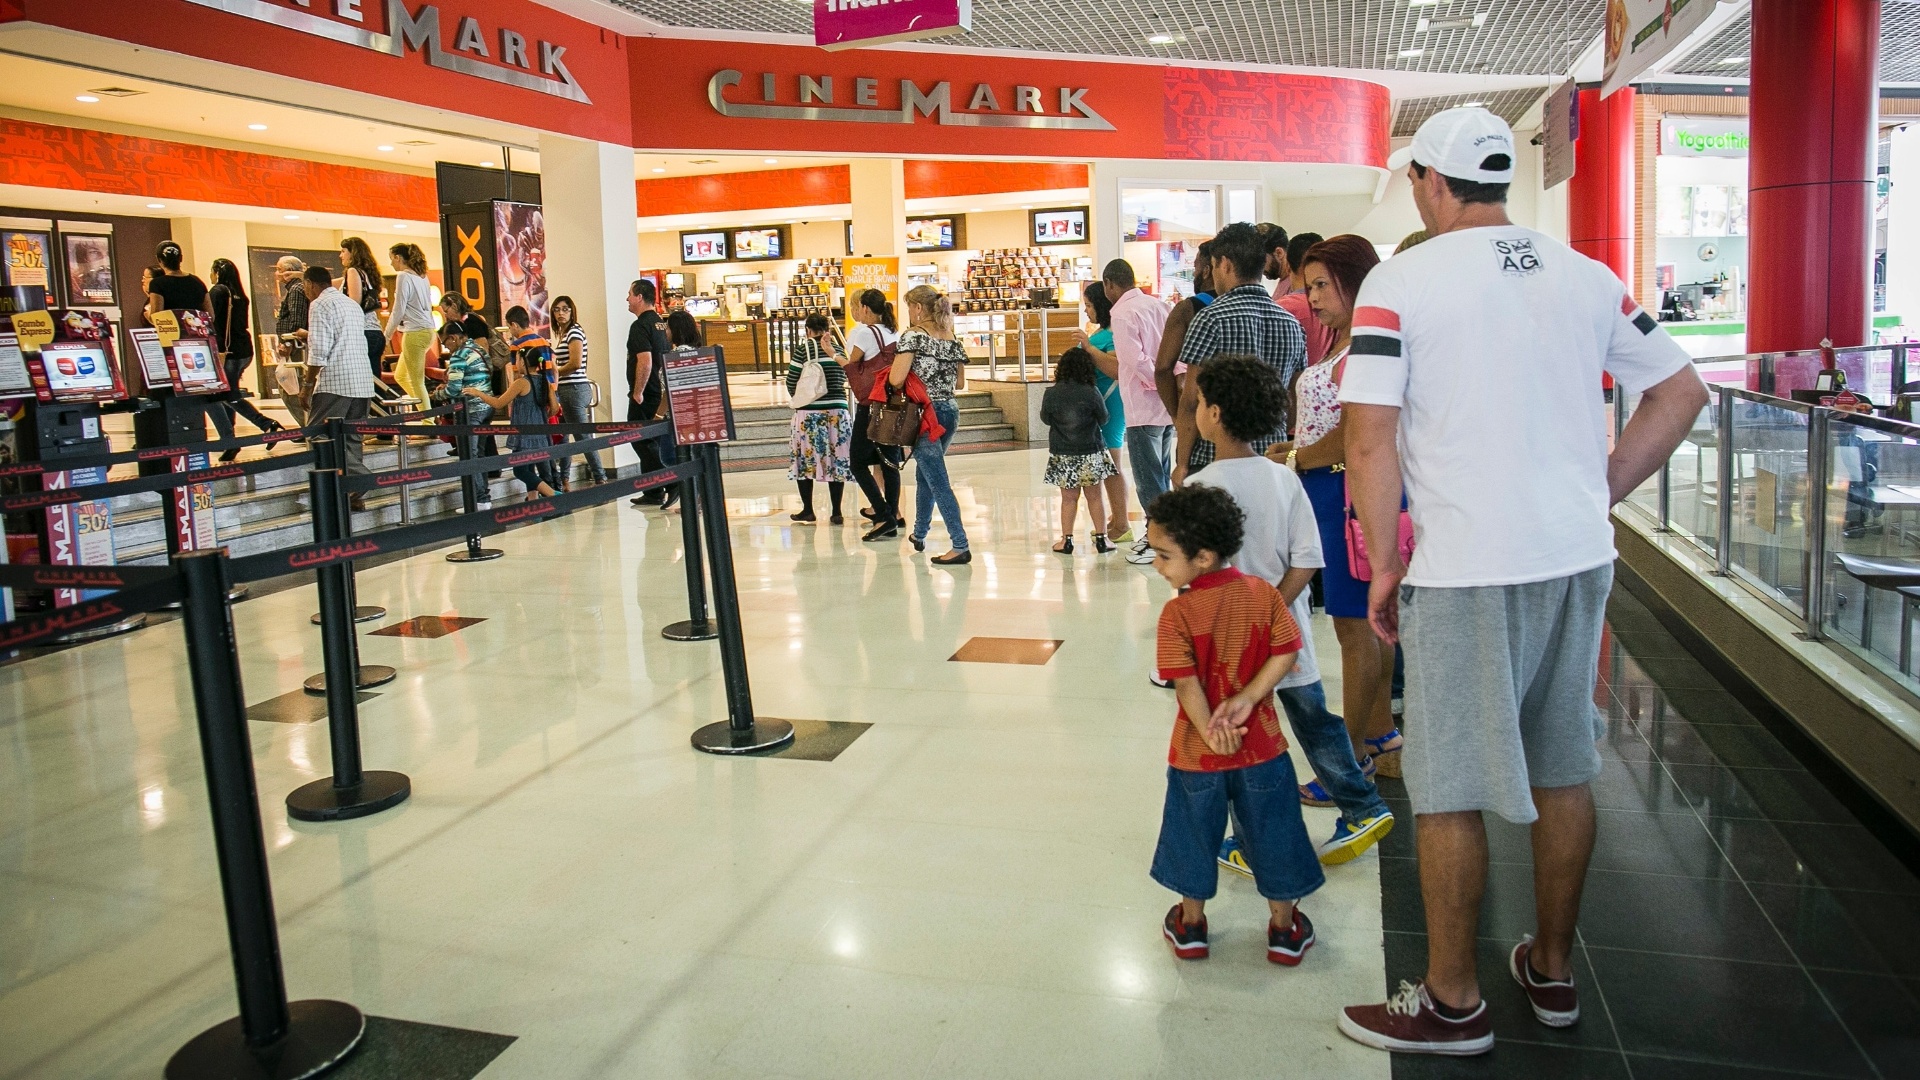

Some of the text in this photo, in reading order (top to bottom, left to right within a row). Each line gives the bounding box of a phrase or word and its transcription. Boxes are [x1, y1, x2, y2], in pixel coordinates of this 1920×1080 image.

[708, 69, 1117, 131] CINEMARK
[845, 274, 898, 284] CHARLIE BROWN
[18, 319, 45, 328] Combo
[159, 326, 178, 334] Express
[21, 328, 51, 337] Express
[262, 431, 304, 442] CINEMARK
[609, 433, 642, 445] CINEMARK
[138, 447, 190, 459] CINEMARK
[508, 451, 551, 465] CINEMARK
[187, 467, 244, 482] CINEMARK
[376, 470, 432, 486] CINEMARK
[633, 471, 678, 489] CINEMARK
[5, 491, 81, 509] CINEMARK
[194, 493, 214, 511] 50%
[495, 502, 556, 523] CINEMARK
[79, 514, 111, 534] 50%
[289, 539, 379, 567] CINEMARK
[34, 571, 124, 585] CINEMARK
